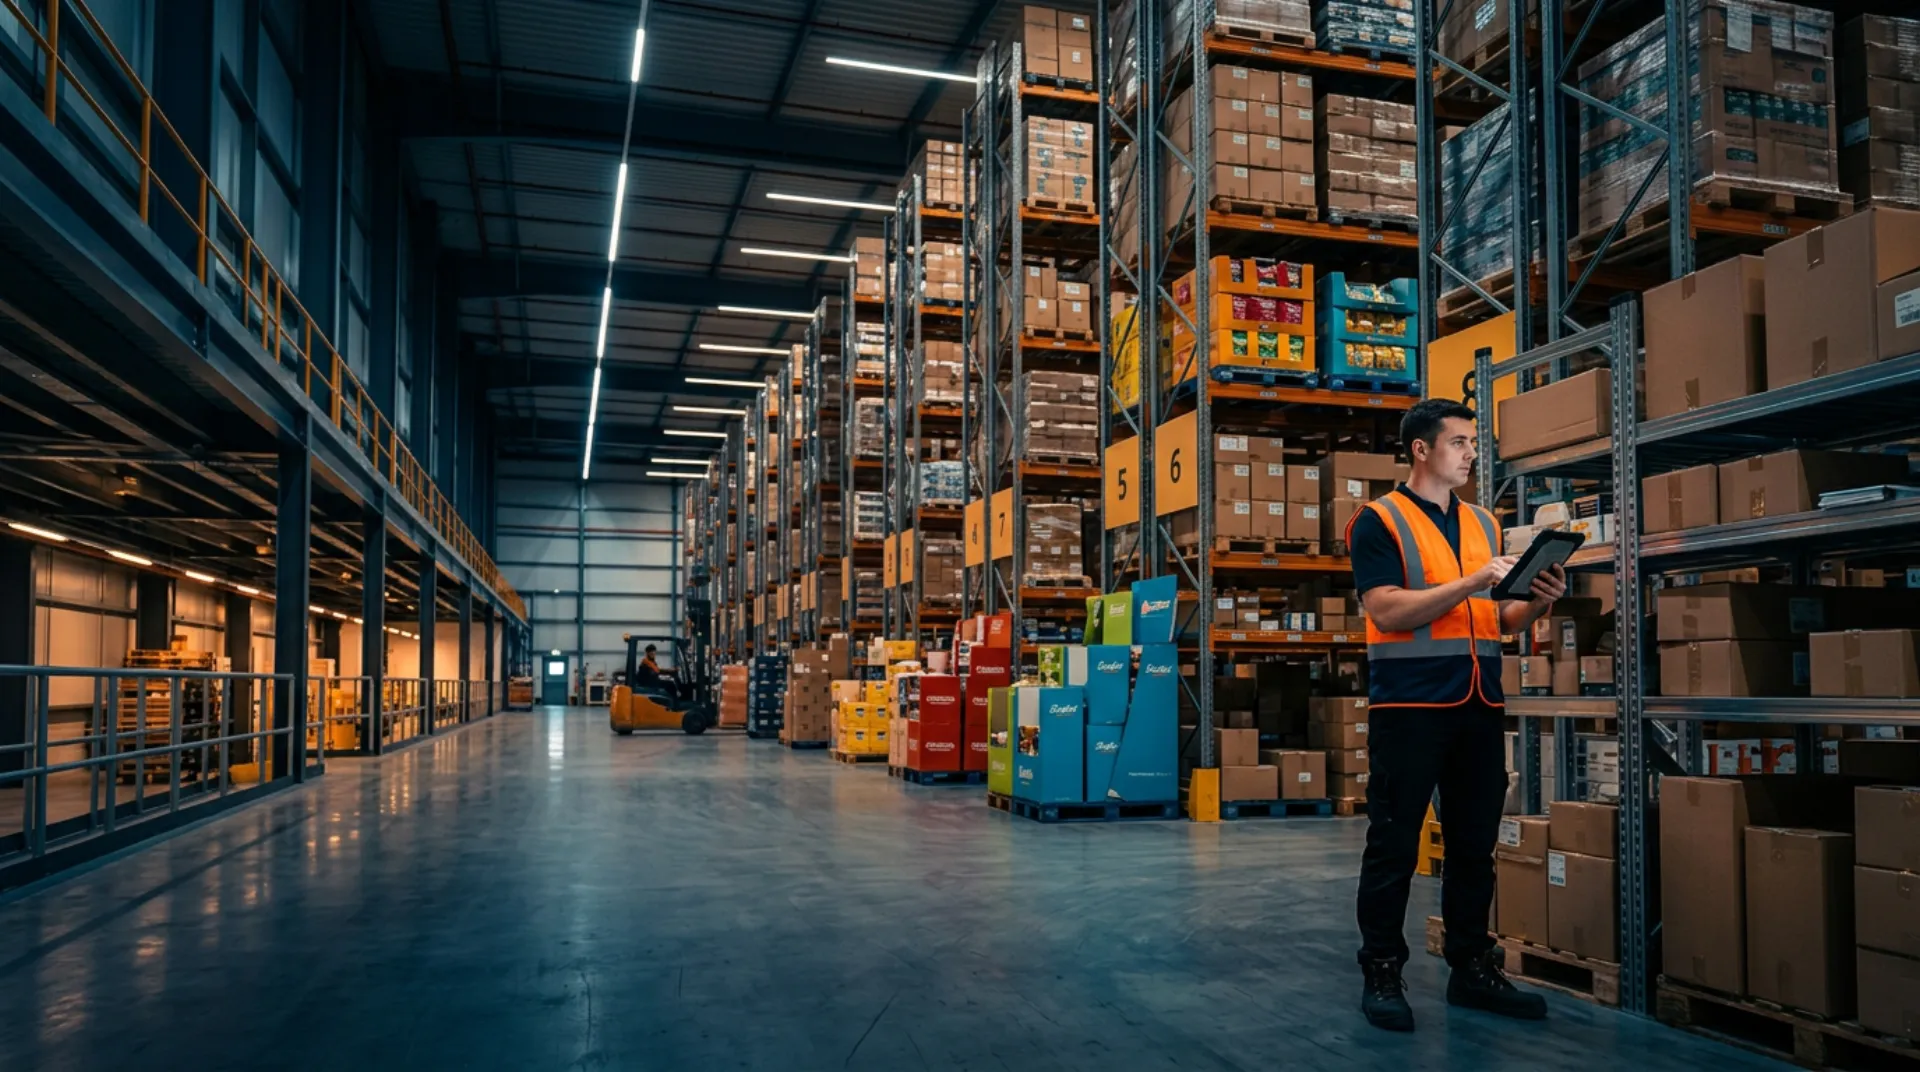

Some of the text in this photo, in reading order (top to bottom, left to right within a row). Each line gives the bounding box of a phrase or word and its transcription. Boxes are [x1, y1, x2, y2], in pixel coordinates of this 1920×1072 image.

[1170, 448, 1181, 483] 6
[1118, 467, 1127, 500] 5
[999, 512, 1005, 538] 7
